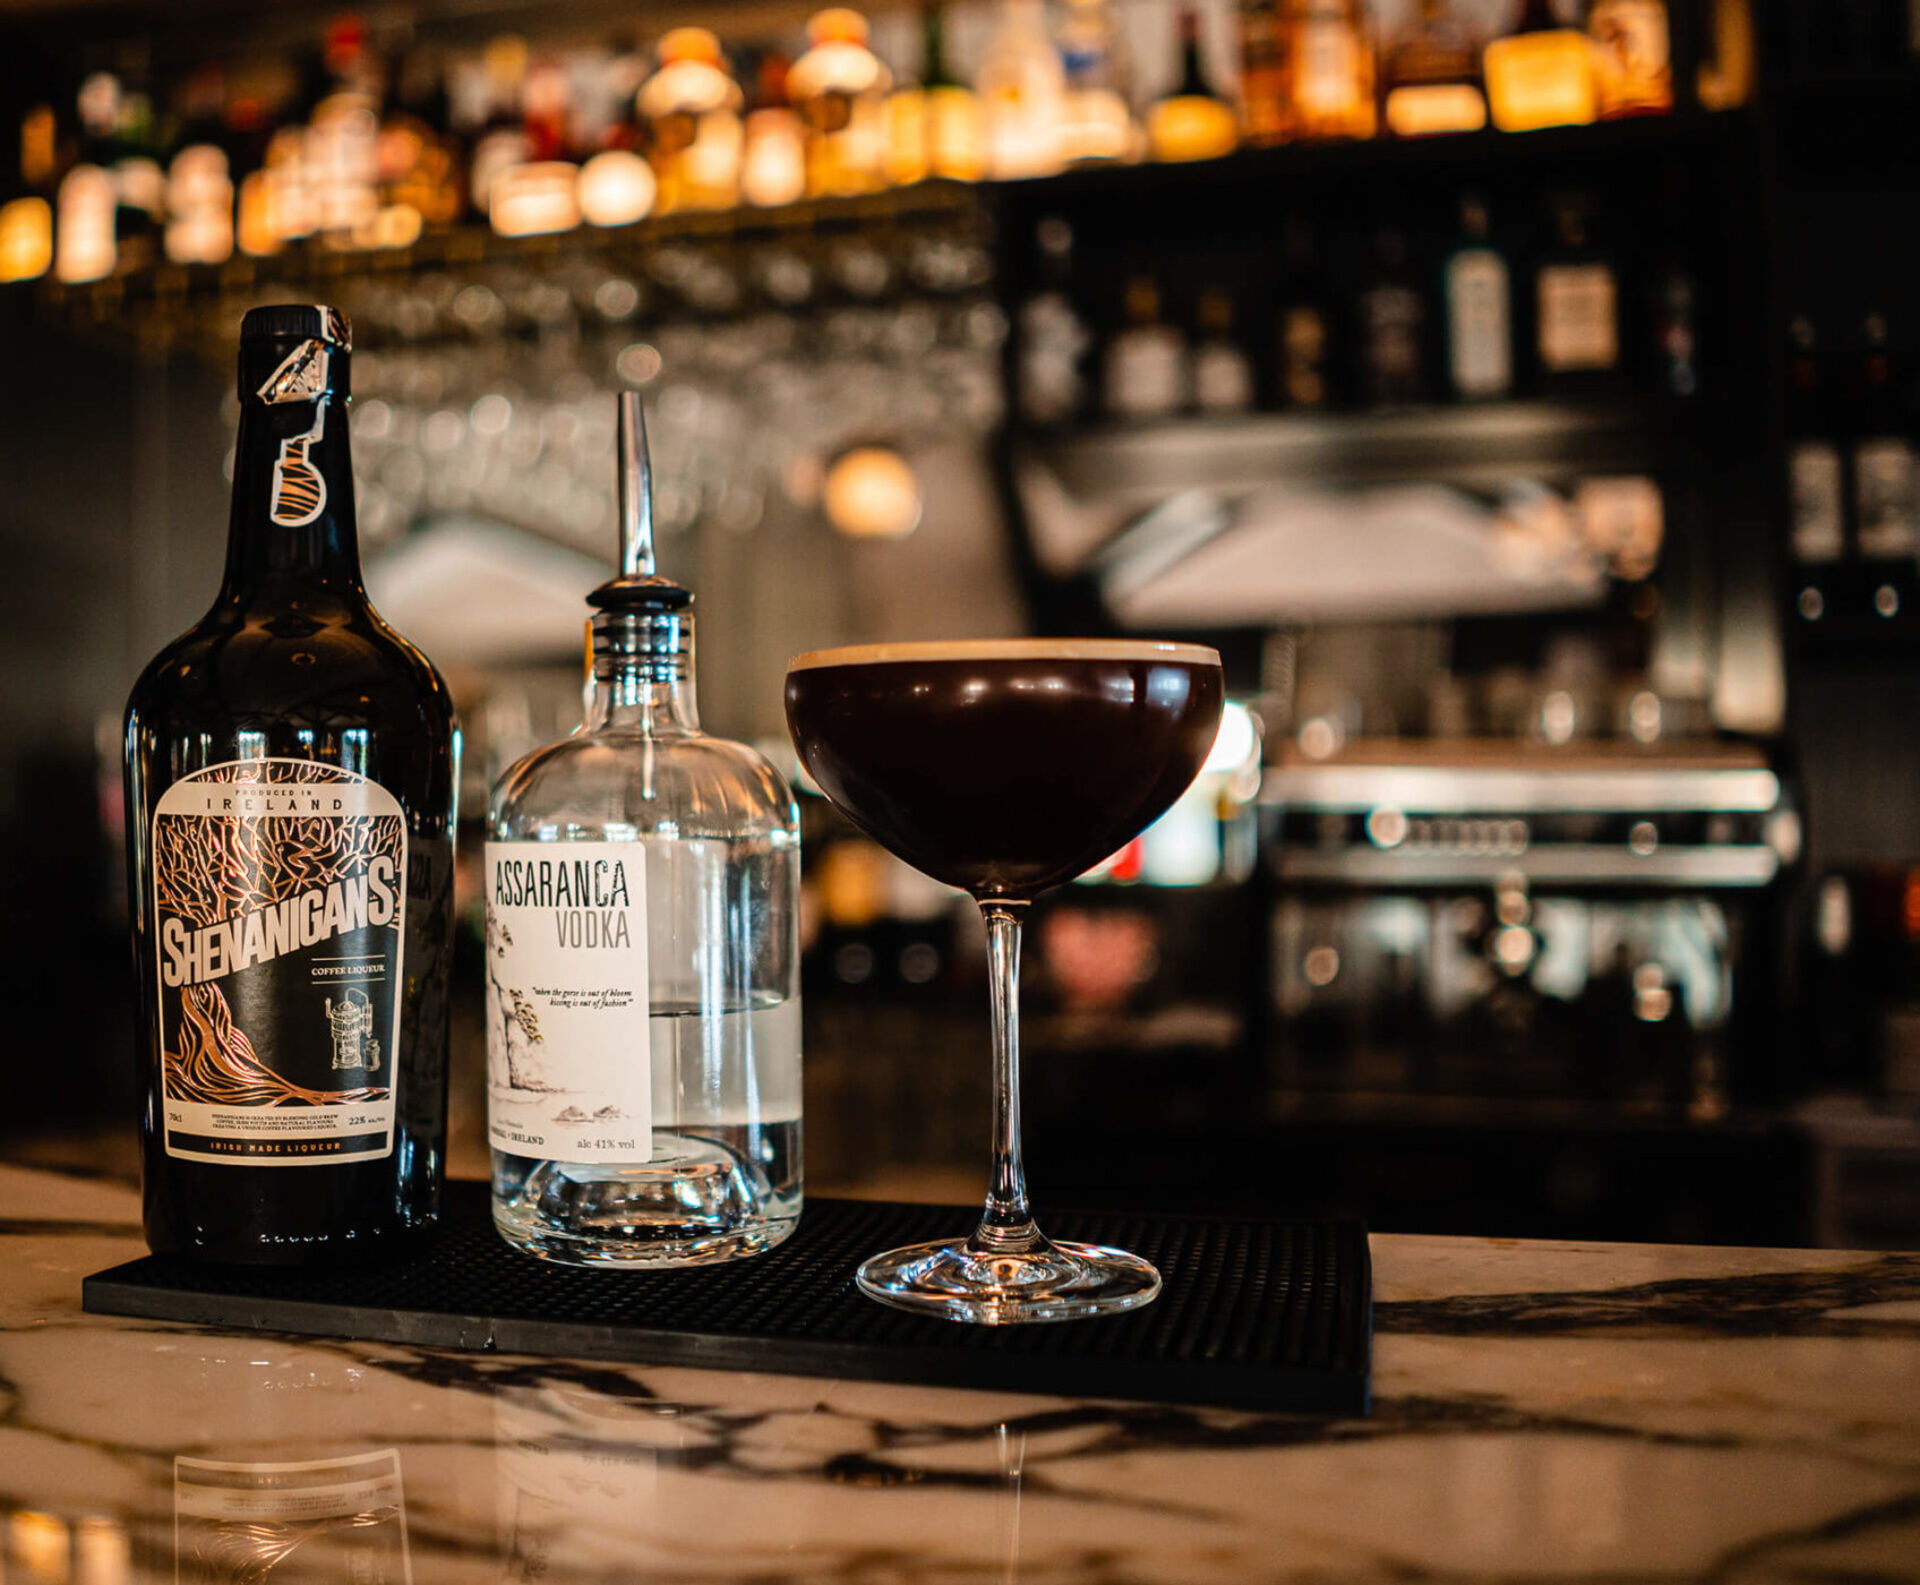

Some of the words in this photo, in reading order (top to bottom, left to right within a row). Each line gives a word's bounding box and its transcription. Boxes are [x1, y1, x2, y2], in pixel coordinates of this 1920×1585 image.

[206, 798, 343, 811] IRELAND
[496, 859, 630, 907] ASSARANCA
[162, 855, 395, 988] SHENANIGANS
[556, 910, 631, 949] VODKA
[311, 967, 346, 976] COFFEE
[347, 964, 386, 974] LIQUEUR
[610, 988, 632, 996] bloom
[349, 1115, 366, 1126] 22%
[511, 1132, 545, 1146] IRELAND
[577, 1138, 591, 1149] alc
[594, 1138, 616, 1149] 41%
[618, 1139, 635, 1150] vol
[210, 1142, 242, 1152] IRISH
[248, 1144, 281, 1153] MADE
[287, 1142, 341, 1153] LIQUEUR
